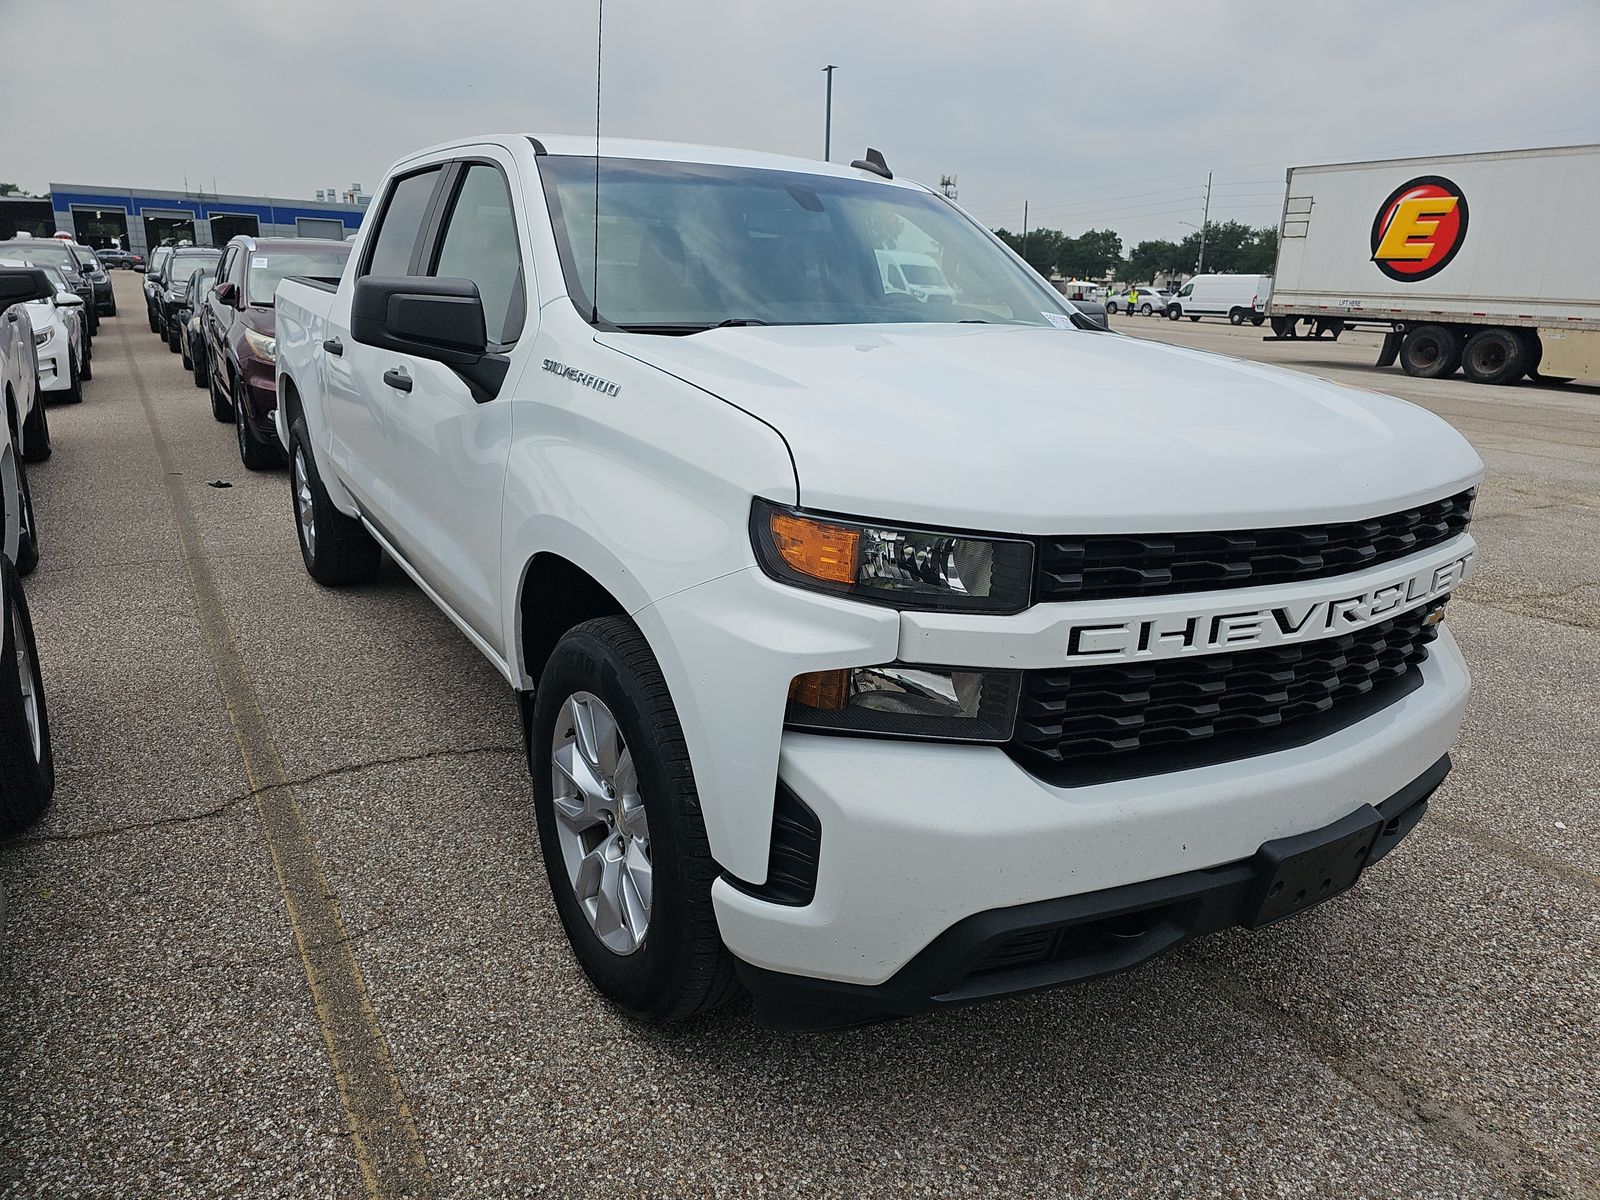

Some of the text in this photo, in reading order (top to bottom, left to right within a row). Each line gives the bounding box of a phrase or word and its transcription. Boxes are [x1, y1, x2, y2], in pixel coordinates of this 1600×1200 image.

[1371, 196, 1459, 261] E
[541, 358, 621, 397] SILVERADO
[1066, 550, 1474, 660] CHEVROLET
